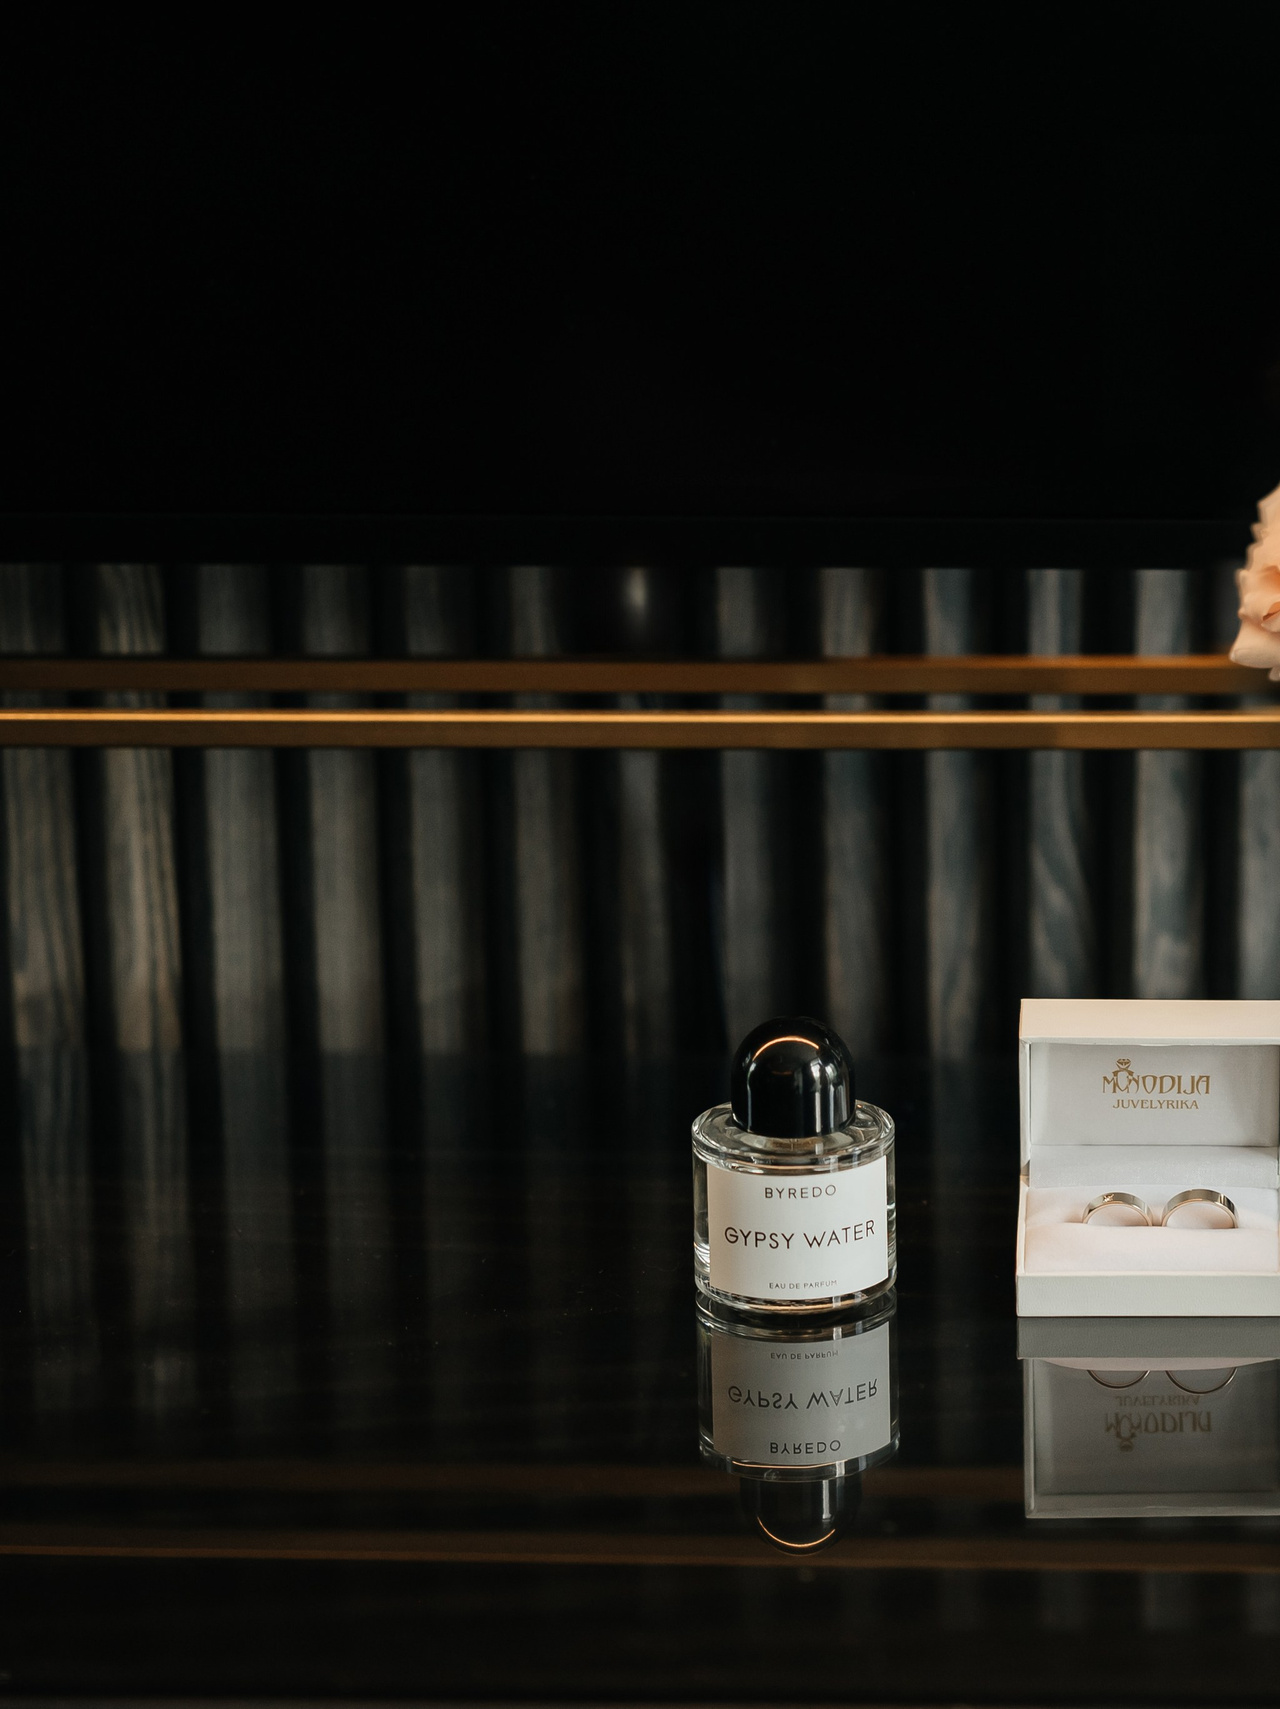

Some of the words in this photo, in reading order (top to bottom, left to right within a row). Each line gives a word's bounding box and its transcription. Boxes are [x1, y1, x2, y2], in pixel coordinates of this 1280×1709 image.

[1112, 1099, 1199, 1110] JUVELYRIKA
[764, 1184, 837, 1199] BYREDO
[724, 1226, 795, 1249] GYPSY
[803, 1219, 876, 1248] WATER
[769, 1282, 787, 1290] EAU
[788, 1282, 800, 1290] DE
[803, 1280, 837, 1289] PARFUM
